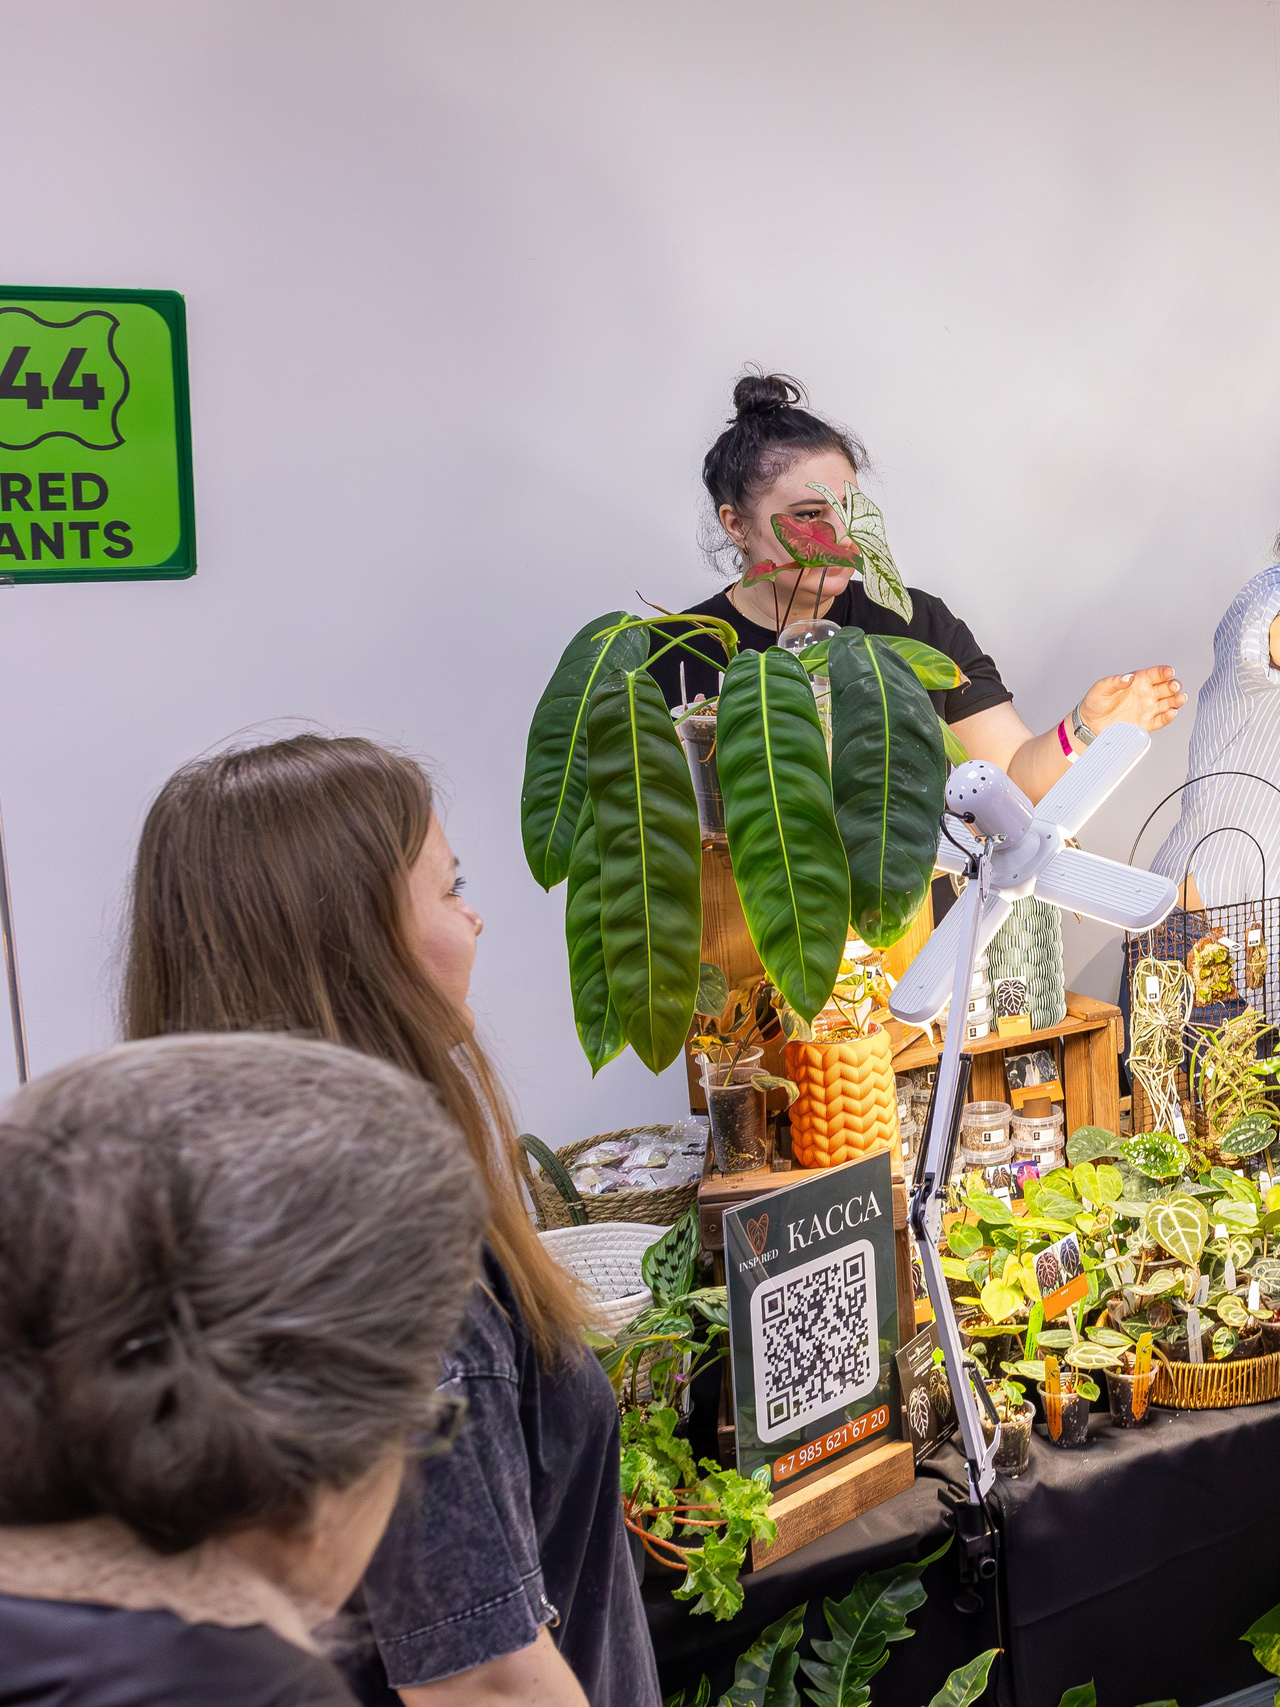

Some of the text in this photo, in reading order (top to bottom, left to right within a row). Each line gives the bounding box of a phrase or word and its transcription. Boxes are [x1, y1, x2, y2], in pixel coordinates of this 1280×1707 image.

[787, 1191, 882, 1254] КАССА
[779, 1409, 886, 1475] +7 985 621 67 20
